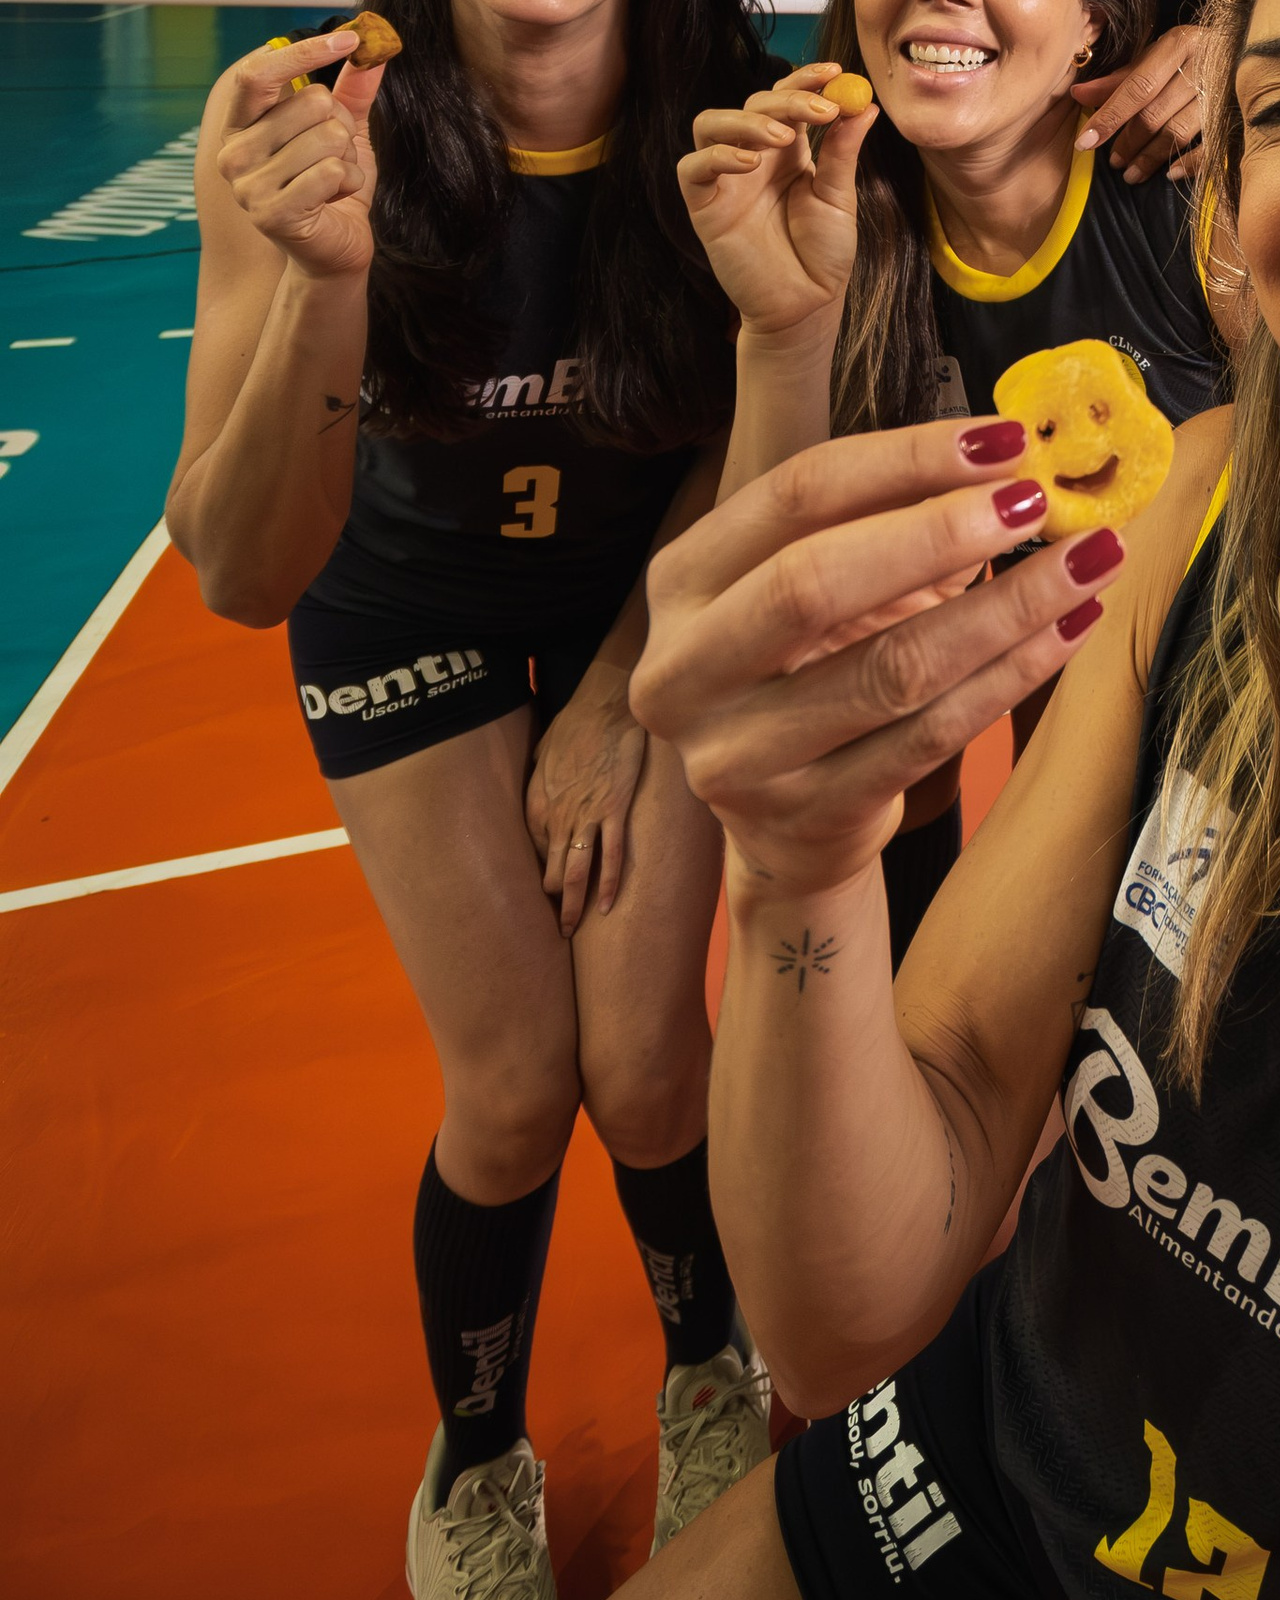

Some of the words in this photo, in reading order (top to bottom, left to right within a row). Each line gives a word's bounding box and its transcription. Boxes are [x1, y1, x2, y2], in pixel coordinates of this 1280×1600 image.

[1109, 335, 1151, 371] CLUBE
[501, 465, 561, 539] 3
[863, 1377, 963, 1571] ntil
[858, 1478, 903, 1584] sorriu.
